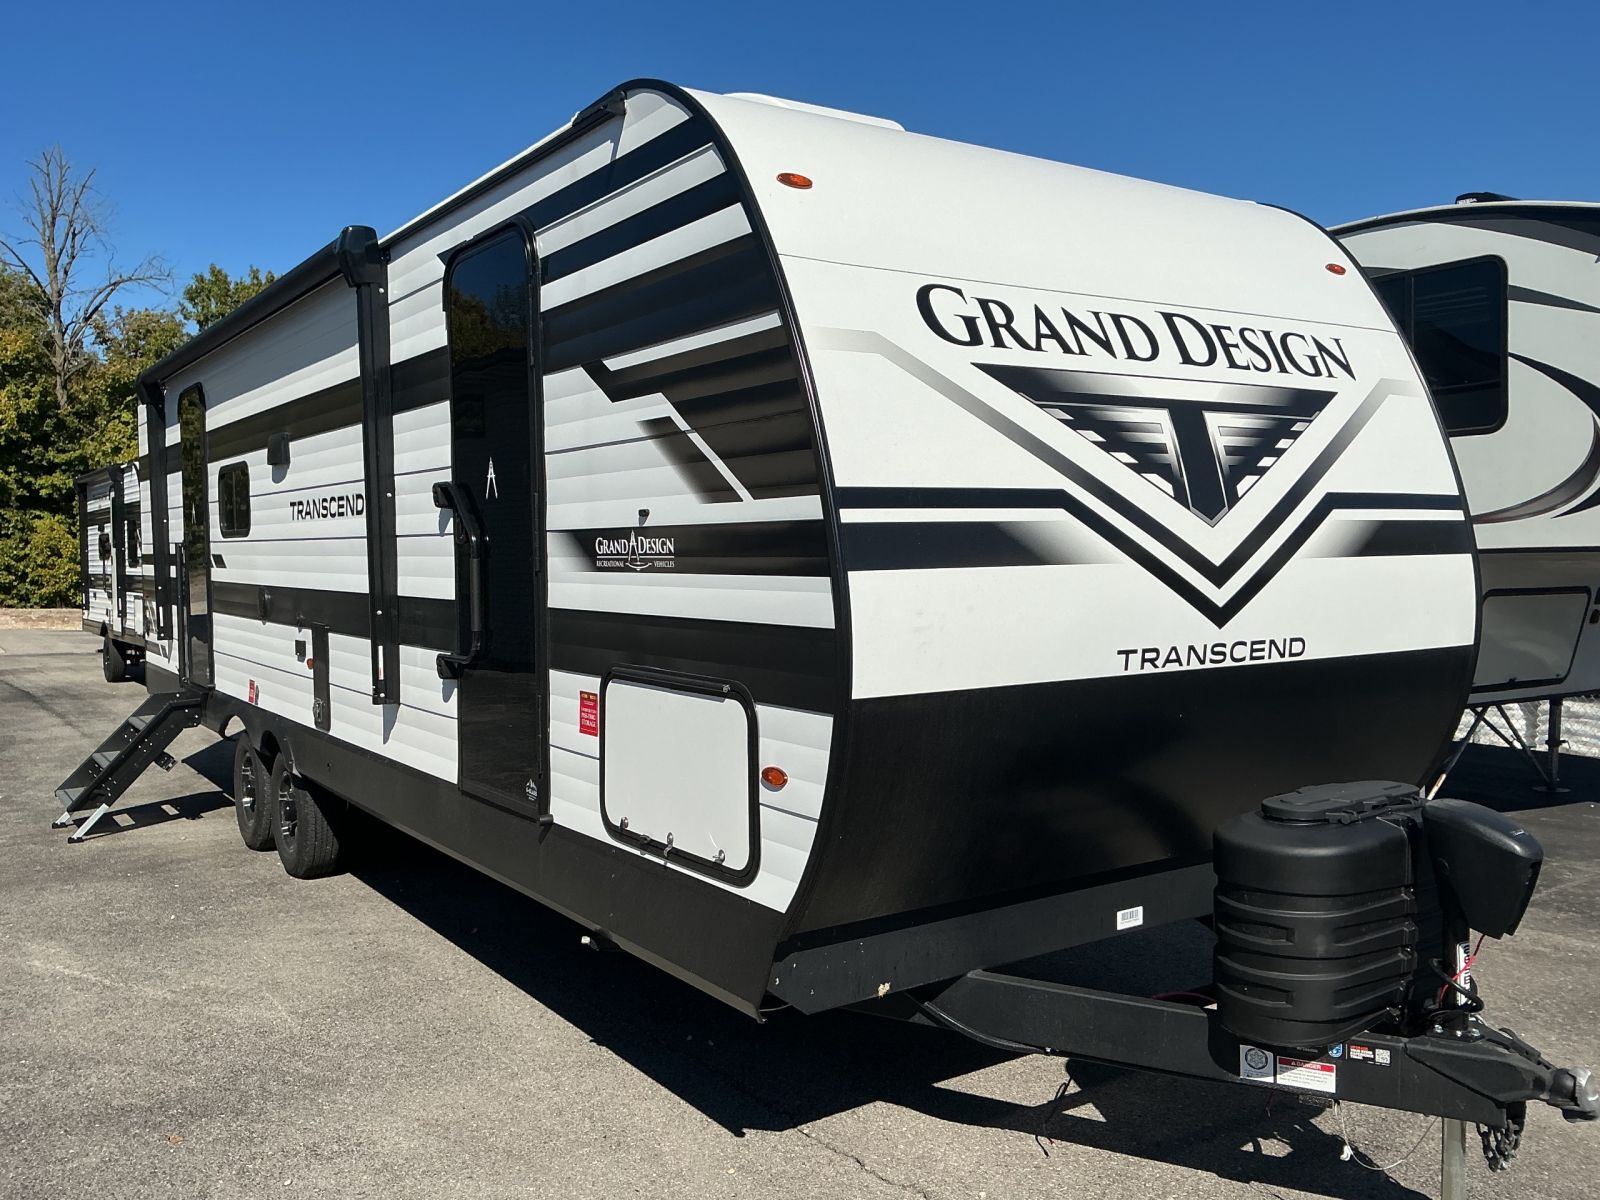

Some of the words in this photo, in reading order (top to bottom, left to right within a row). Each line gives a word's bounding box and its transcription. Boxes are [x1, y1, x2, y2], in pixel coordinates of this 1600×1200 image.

[916, 283, 1160, 362] GRAND
[1155, 310, 1356, 382] DESIGN
[290, 493, 365, 521] TRANSCEND
[595, 537, 629, 554] GRAND
[637, 536, 674, 554] DESIGN
[596, 560, 625, 568] RECREATIONAL
[653, 560, 675, 568] VEHICLES
[1116, 637, 1306, 671] TRANSCEND
[1296, 1061, 1322, 1071] DANGER
